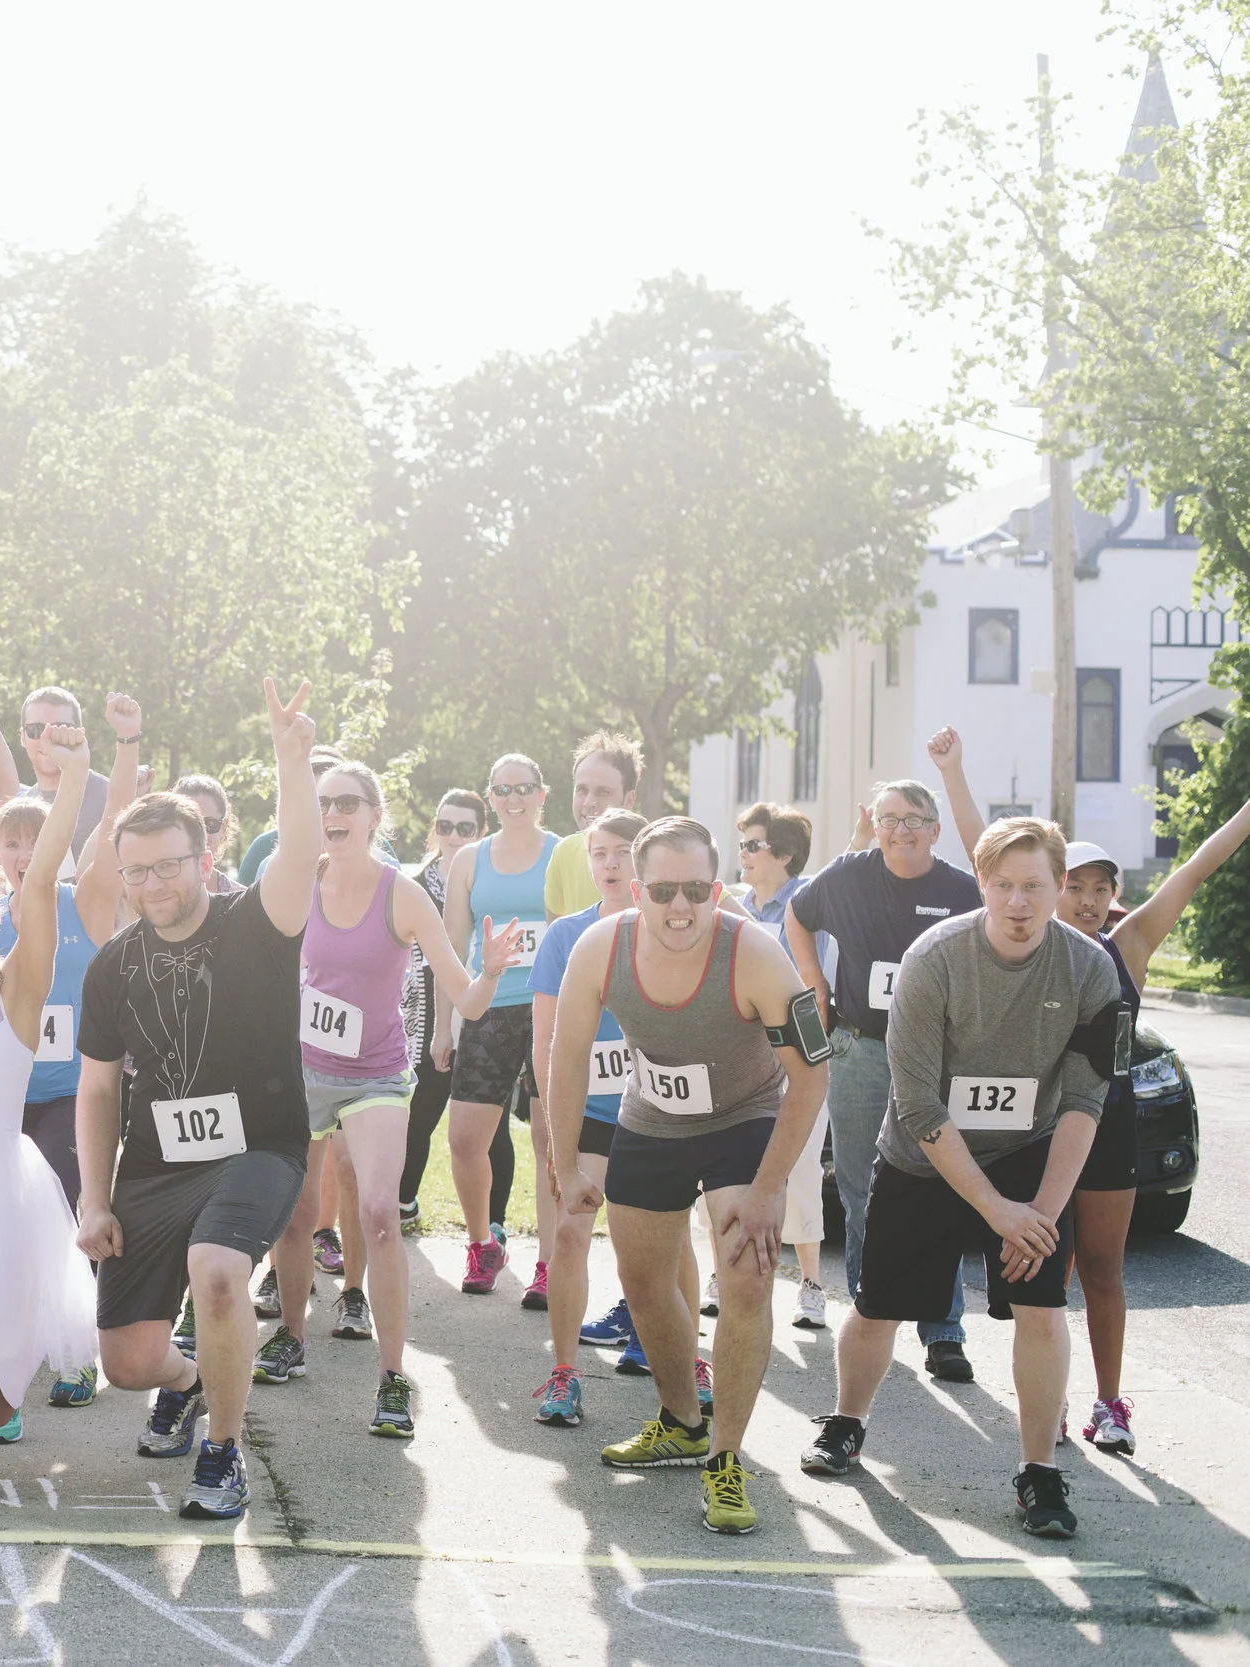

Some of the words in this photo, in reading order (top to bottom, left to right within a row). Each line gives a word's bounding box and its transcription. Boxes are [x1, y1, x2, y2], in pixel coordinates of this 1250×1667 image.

[310, 1001, 347, 1038] 104
[967, 1085, 1017, 1112] 132
[173, 1108, 224, 1143] 102
